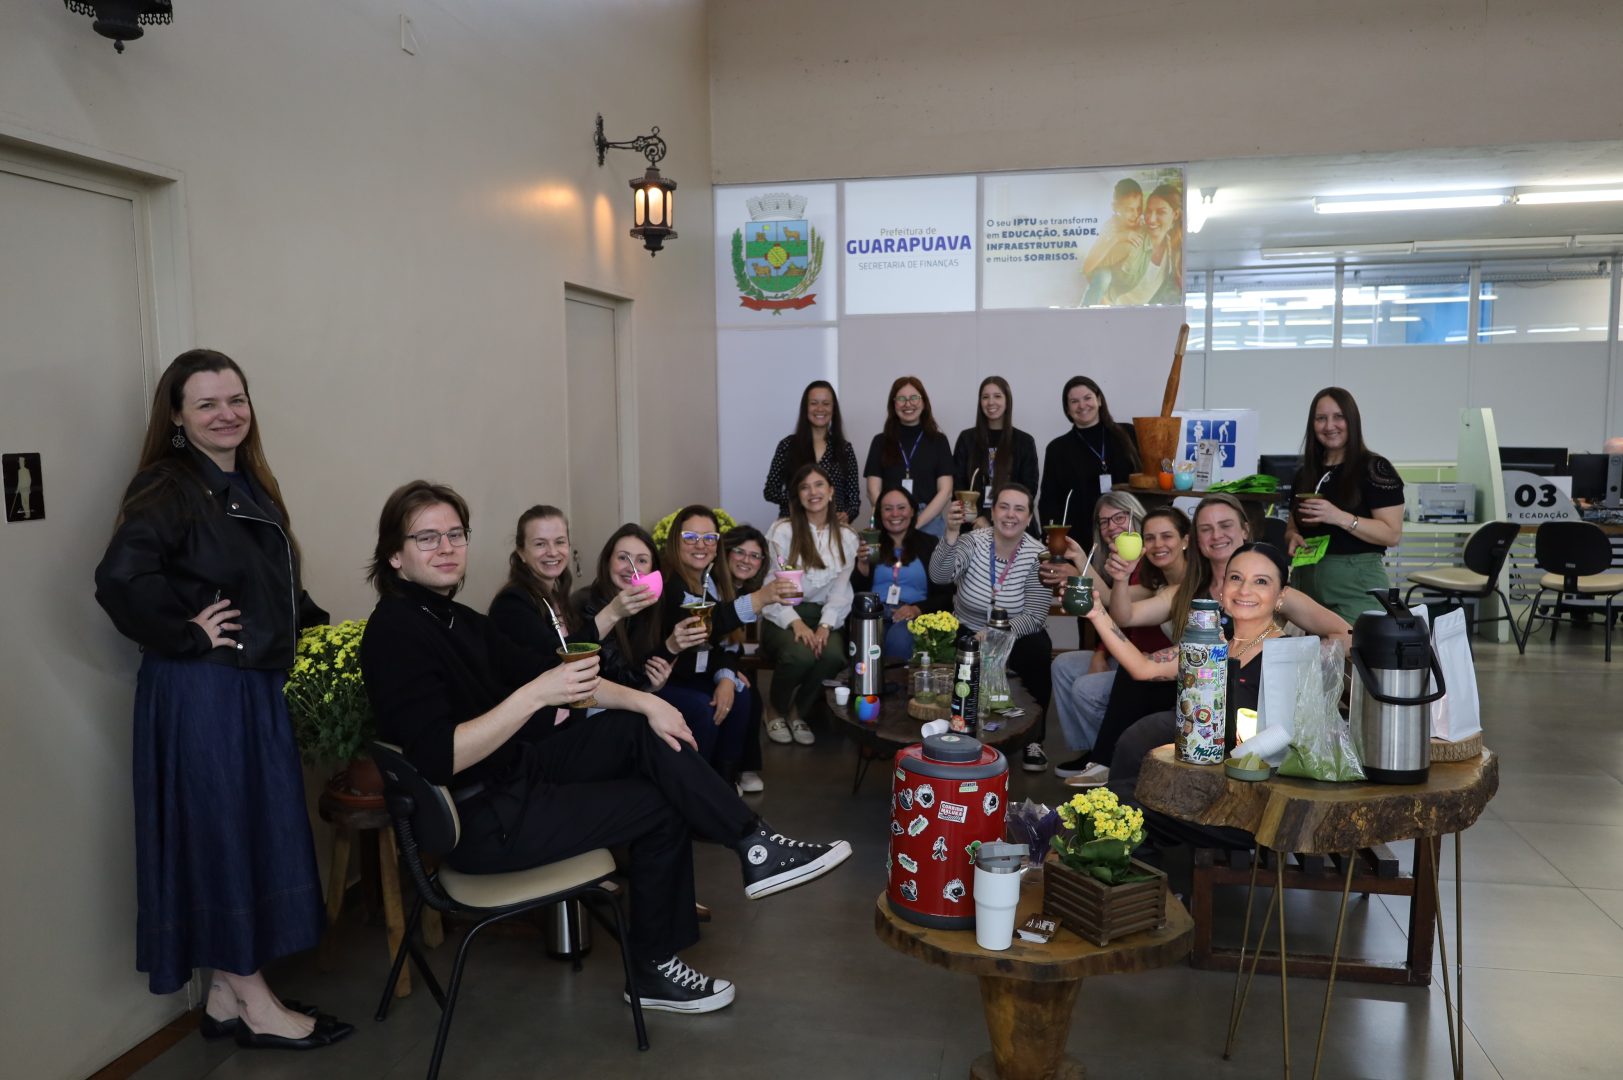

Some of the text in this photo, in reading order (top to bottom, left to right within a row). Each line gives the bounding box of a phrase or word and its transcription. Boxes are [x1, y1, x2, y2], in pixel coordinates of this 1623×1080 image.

[986, 219, 994, 227] O
[1013, 218, 1037, 226] IPTU
[1050, 216, 1098, 225] transforma
[880, 226, 937, 237] Prefeitura de
[846, 235, 972, 254] GUARAPUAVA
[986, 241, 1078, 251] INFRAESTRUTURA
[993, 254, 1021, 263] muitos
[1024, 252, 1078, 262] SORRISOS.
[858, 258, 959, 271] SECRETARIA DE FINANÇAS
[1514, 484, 1557, 508] 03
